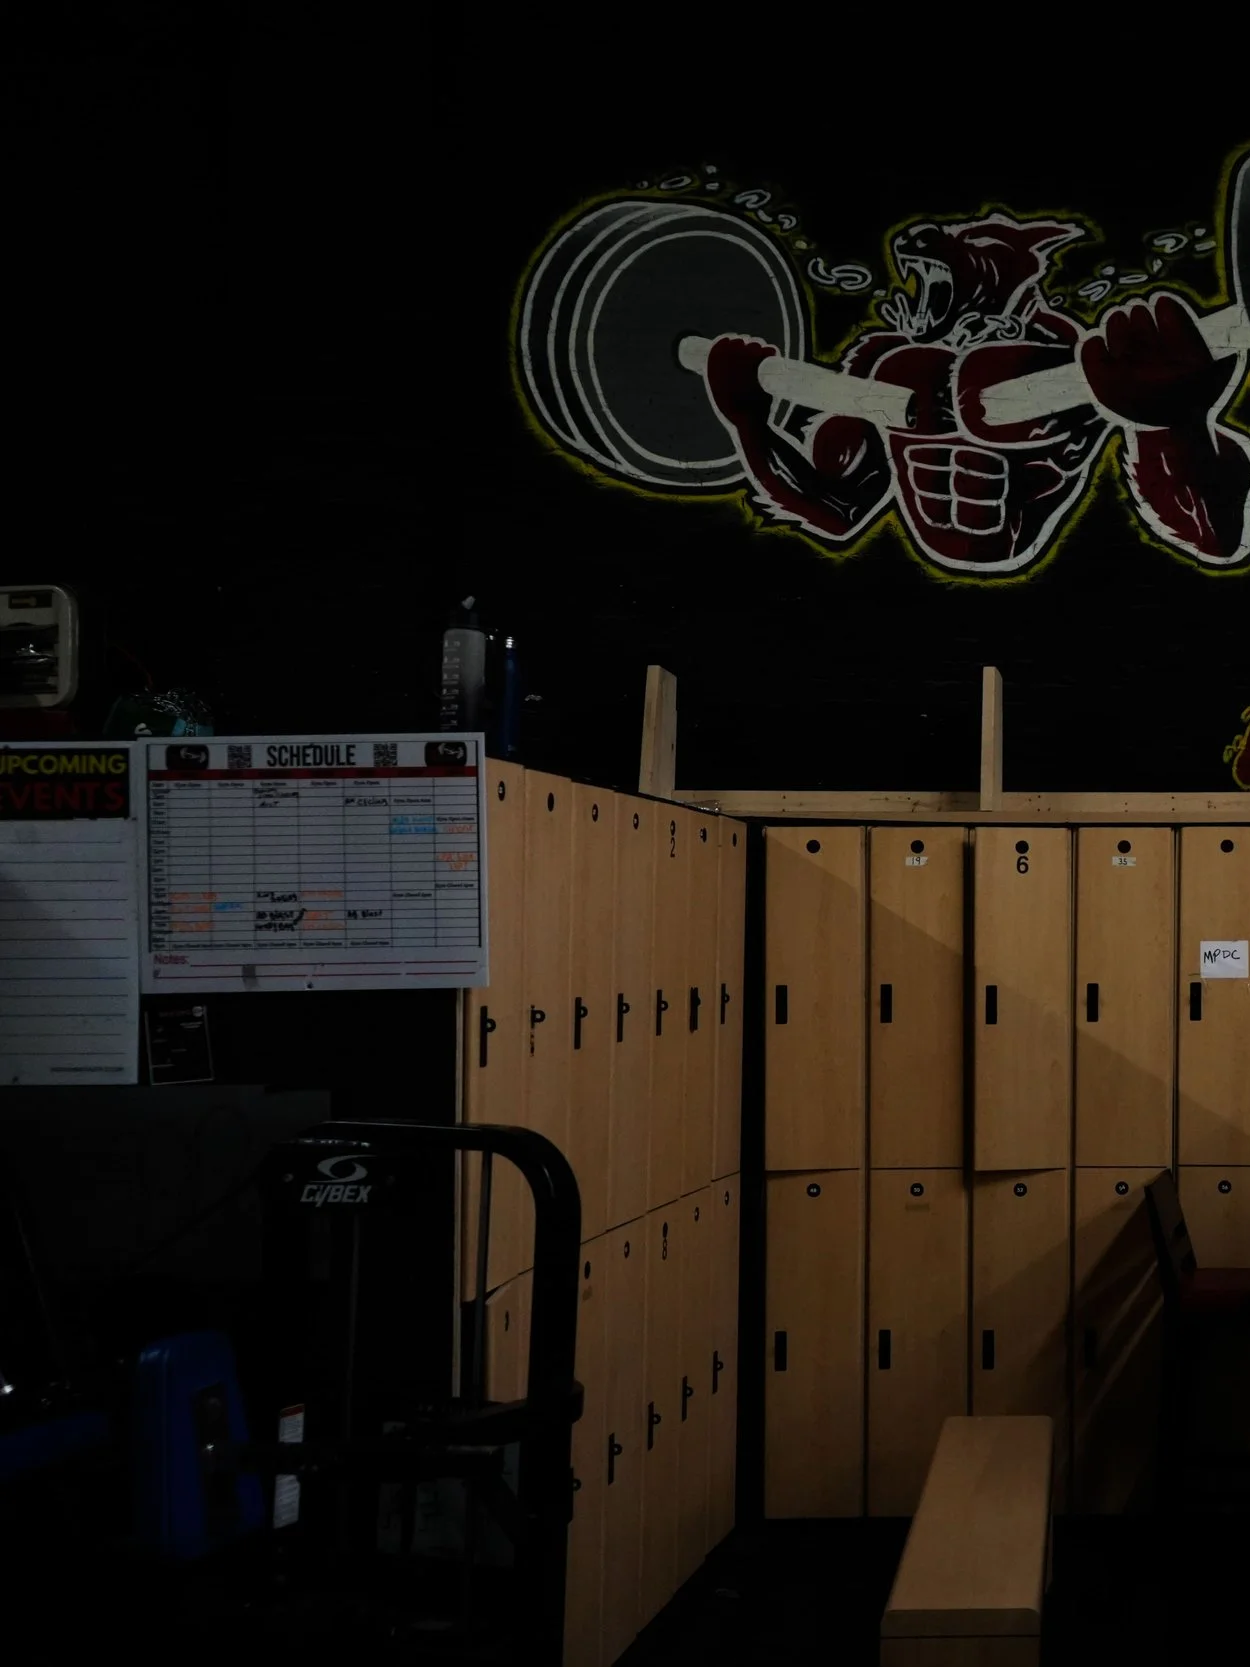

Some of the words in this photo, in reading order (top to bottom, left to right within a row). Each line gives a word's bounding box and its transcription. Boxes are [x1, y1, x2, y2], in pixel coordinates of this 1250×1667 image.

[266, 743, 357, 768] SCHEDULE
[669, 836, 676, 858] 2
[1015, 855, 1029, 874] 6
[1203, 948, 1241, 964] MPDC
[300, 1184, 372, 1208] CYBEX
[661, 1236, 668, 1260] 8
